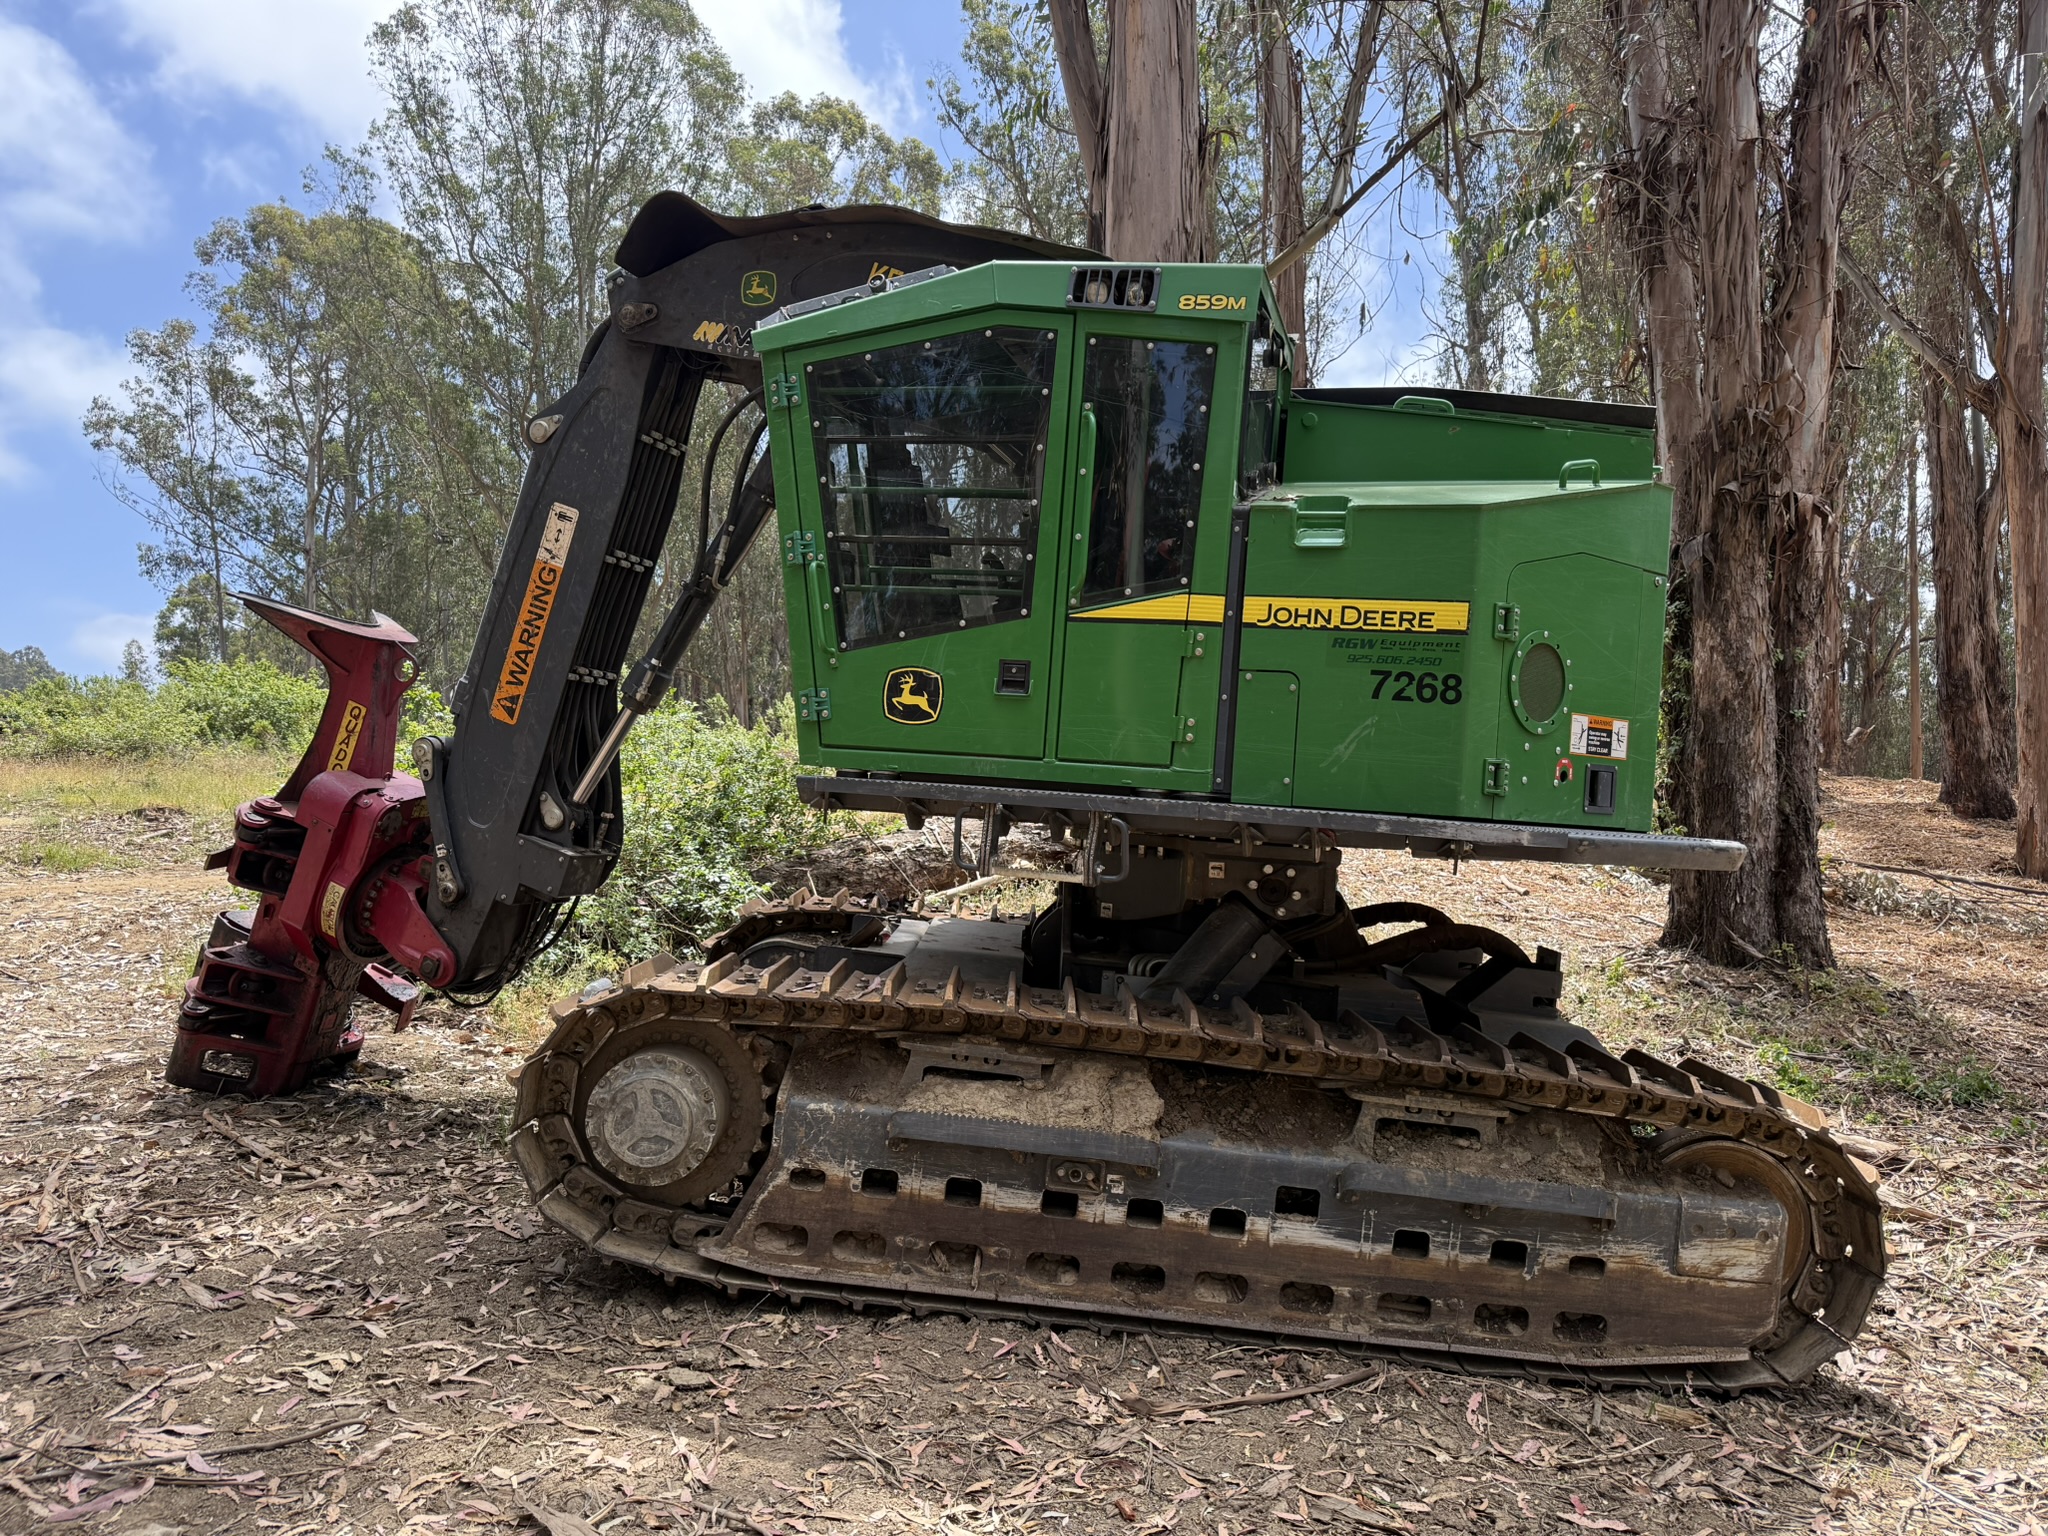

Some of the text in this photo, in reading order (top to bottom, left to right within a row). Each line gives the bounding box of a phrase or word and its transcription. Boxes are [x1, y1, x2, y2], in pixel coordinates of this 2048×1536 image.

[1178, 294, 1247, 310] 859M
[505, 566, 557, 687] WARNING
[1257, 603, 1436, 629] JOHN DEERE
[1331, 637, 1379, 650] RGW
[1380, 638, 1462, 649] Equipment
[1346, 654, 1443, 666] 925.606.2450
[1369, 669, 1463, 705] 7268
